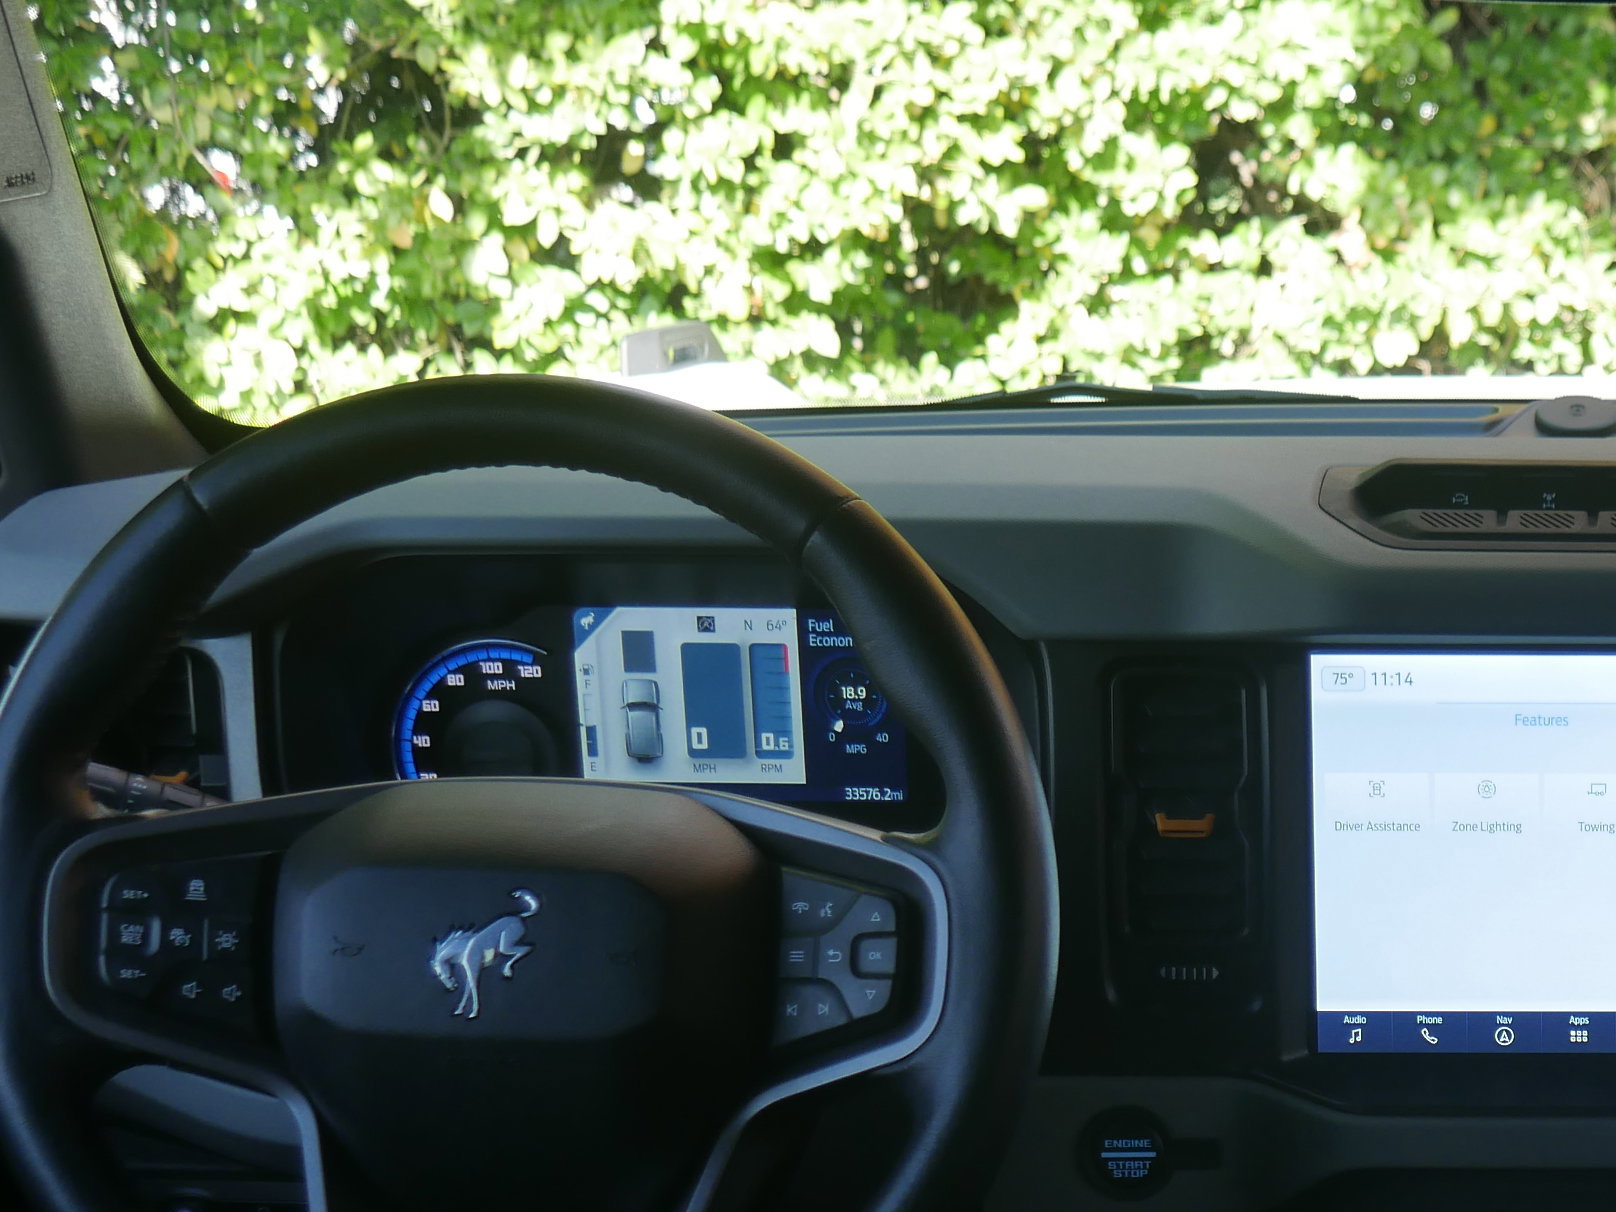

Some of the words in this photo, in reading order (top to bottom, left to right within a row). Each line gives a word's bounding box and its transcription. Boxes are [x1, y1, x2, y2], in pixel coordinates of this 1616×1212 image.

[744, 620, 752, 630] N
[808, 619, 833, 631] Fuel
[480, 663, 502, 674] 100
[518, 665, 541, 677] 120
[447, 675, 464, 685] 80
[585, 680, 590, 688] F
[1332, 672, 1353, 686] 75°
[1371, 672, 1413, 686] 11:14
[488, 680, 516, 690] MPH
[841, 687, 866, 699] 18.9
[422, 701, 439, 711] 60
[846, 701, 863, 711] Avg
[1515, 714, 1568, 726] Features
[413, 736, 430, 747] 40
[691, 728, 708, 749] 0
[761, 733, 788, 750] 0.6
[829, 734, 835, 742] 0
[877, 733, 888, 742] 40
[846, 745, 867, 754] MPG
[591, 762, 596, 771] E
[693, 764, 716, 772] MPH
[761, 764, 782, 772] RPM
[1334, 821, 1364, 832] Driver
[1367, 821, 1420, 832] Assistance
[1452, 821, 1477, 832] Zone
[1480, 821, 1522, 834] Lighting
[1578, 821, 1615, 834] Towing
[869, 951, 881, 960] OK
[1344, 1016, 1366, 1024] Audio
[1417, 1016, 1442, 1024] Phone
[1497, 1016, 1512, 1024] Nav
[1569, 1016, 1589, 1026] Apps
[1104, 1139, 1152, 1148] ENGINE
[1108, 1161, 1151, 1169] START
